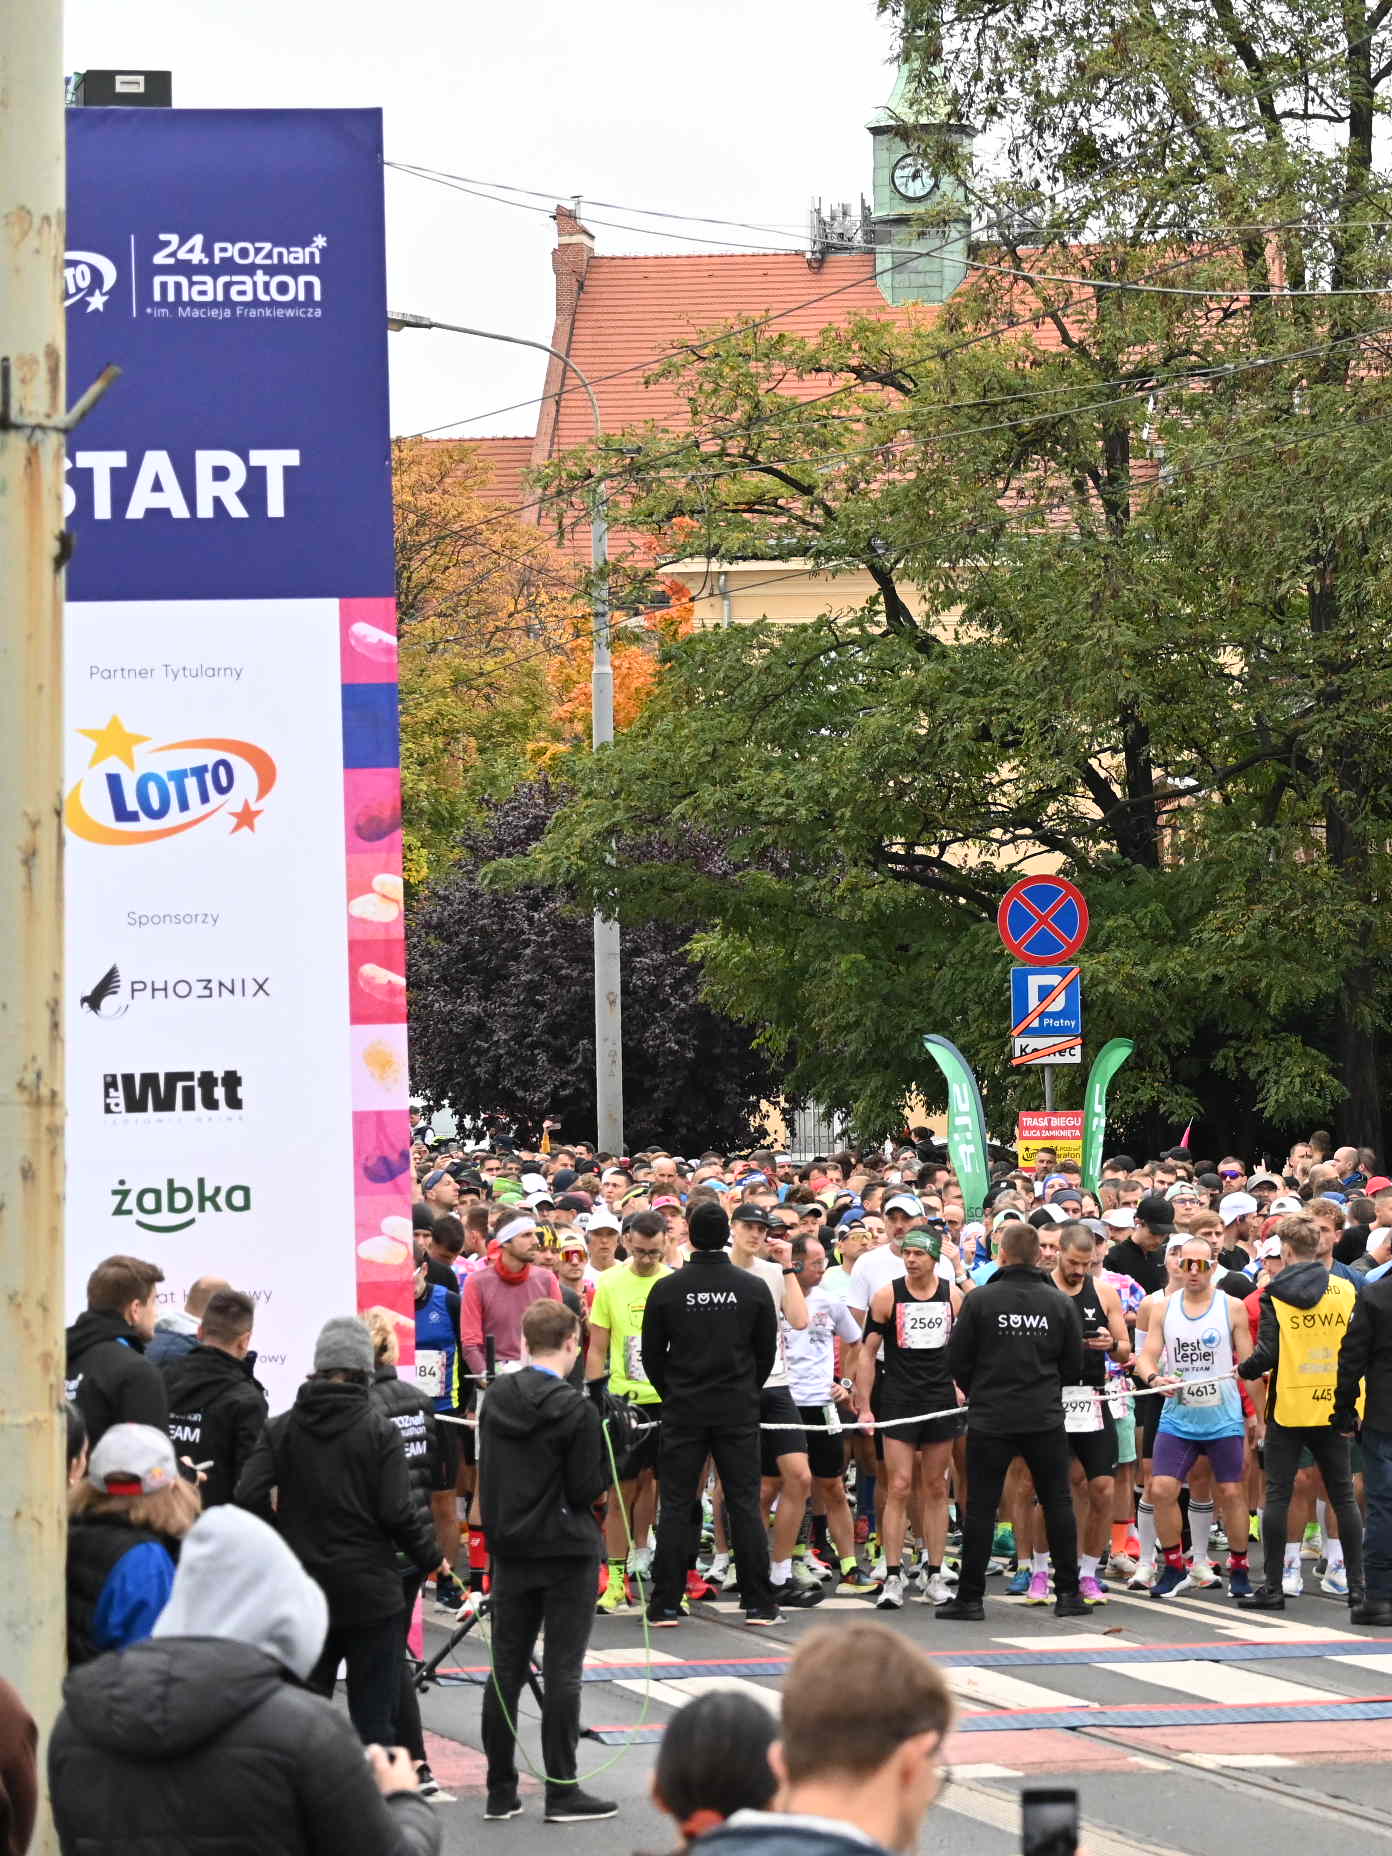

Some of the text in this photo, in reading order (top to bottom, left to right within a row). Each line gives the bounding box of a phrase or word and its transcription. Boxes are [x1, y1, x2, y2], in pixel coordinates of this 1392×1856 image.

[153, 269, 322, 302] maraton
[178, 306, 232, 320] Macieja
[236, 306, 322, 318] Frankiewicza
[64, 448, 300, 520] TART
[89, 663, 244, 681] Partner Tytularny
[105, 758, 235, 823] LOTTO
[126, 908, 220, 928] Sponsorzy
[1022, 1116, 1082, 1127] TRASA BIEGU
[1022, 1129, 1081, 1138] ULICA ZAMKNIĘTA
[110, 1176, 252, 1217] żabka
[686, 1292, 737, 1305] SOWA
[910, 1317, 943, 1329] 2569
[998, 1314, 1048, 1330] SOWA
[1290, 1312, 1346, 1330] SOWA
[1187, 1383, 1217, 1397] 4613
